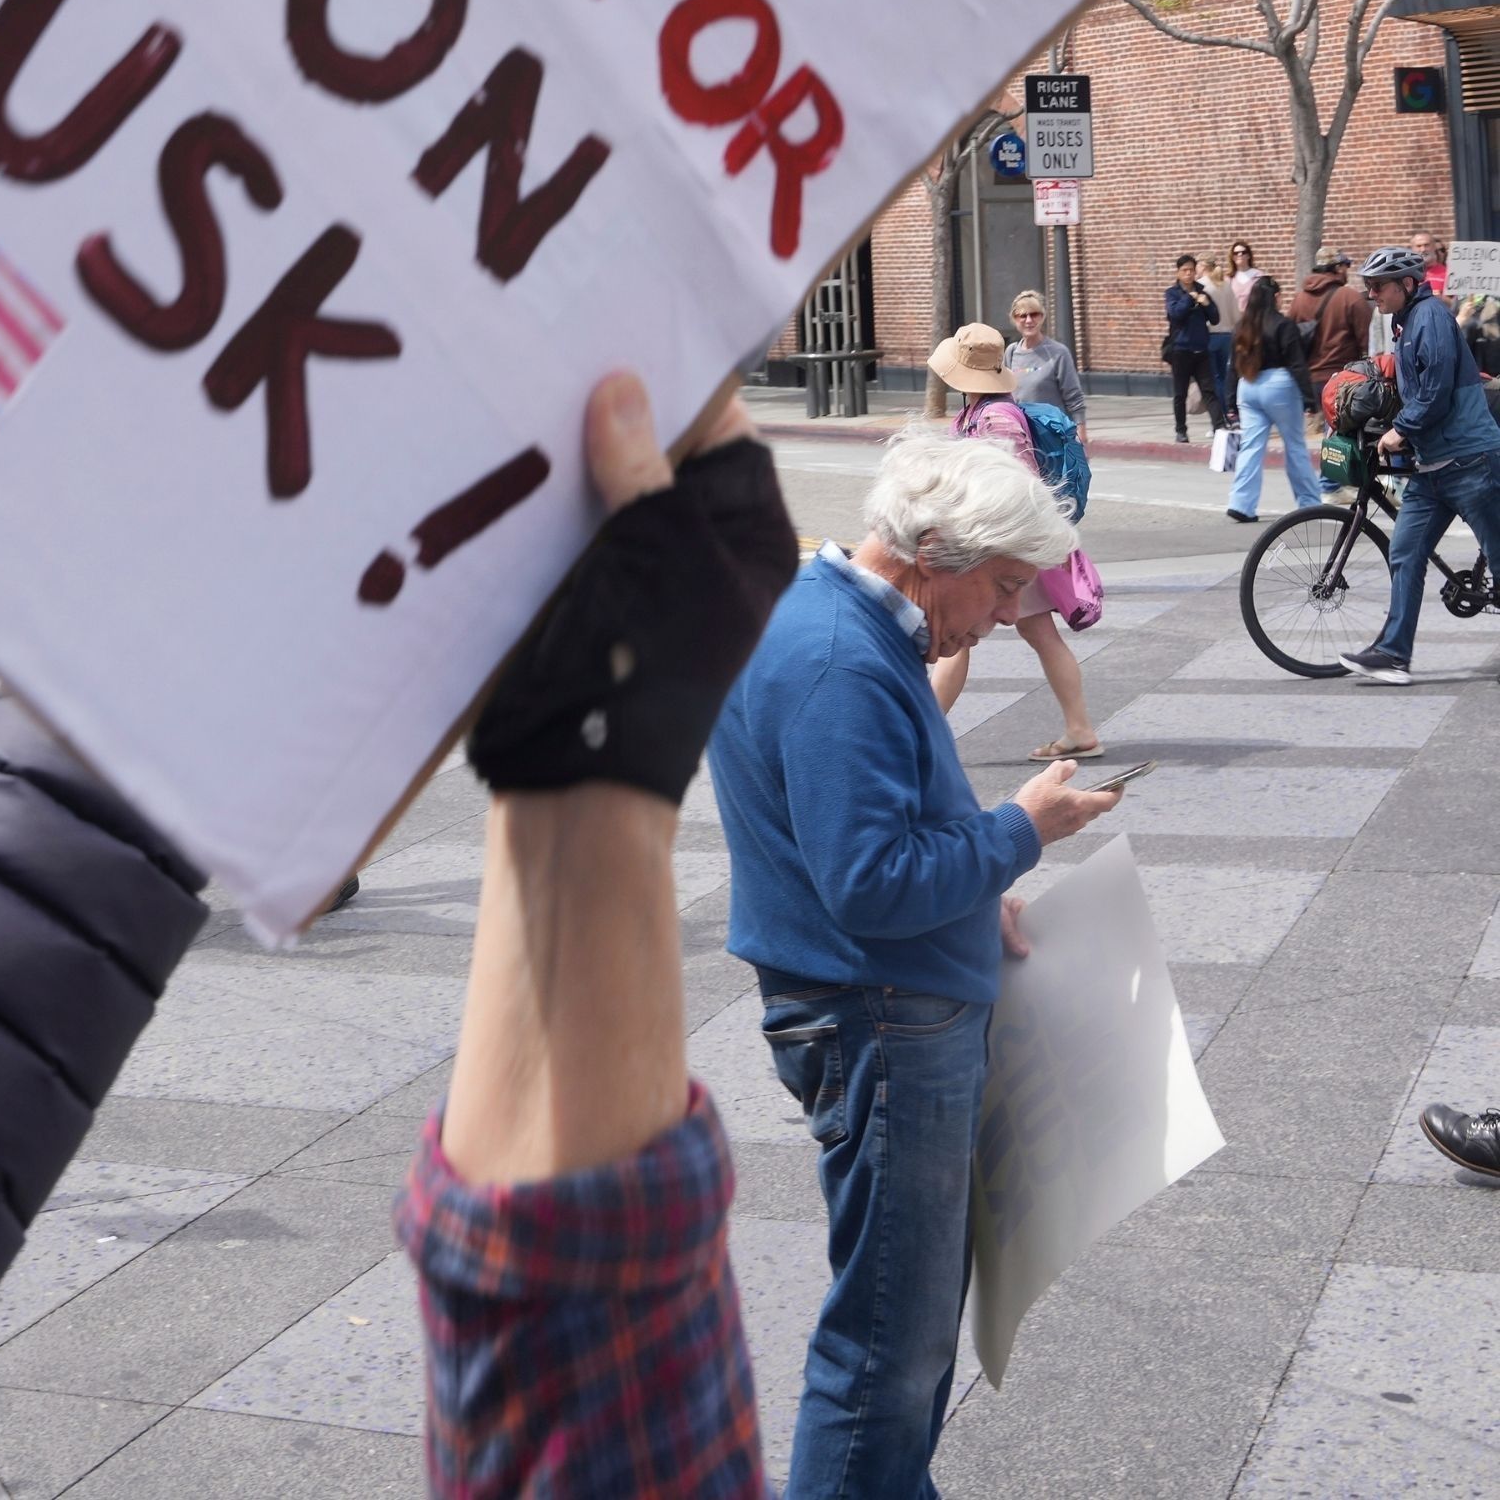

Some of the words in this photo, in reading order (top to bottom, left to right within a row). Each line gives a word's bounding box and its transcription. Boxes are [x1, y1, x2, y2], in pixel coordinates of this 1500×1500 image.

[1037, 81, 1079, 93] RIGHT
[1040, 96, 1079, 108] LANE
[1037, 131, 1083, 147] BUSES
[1043, 153, 1078, 169] ONLY
